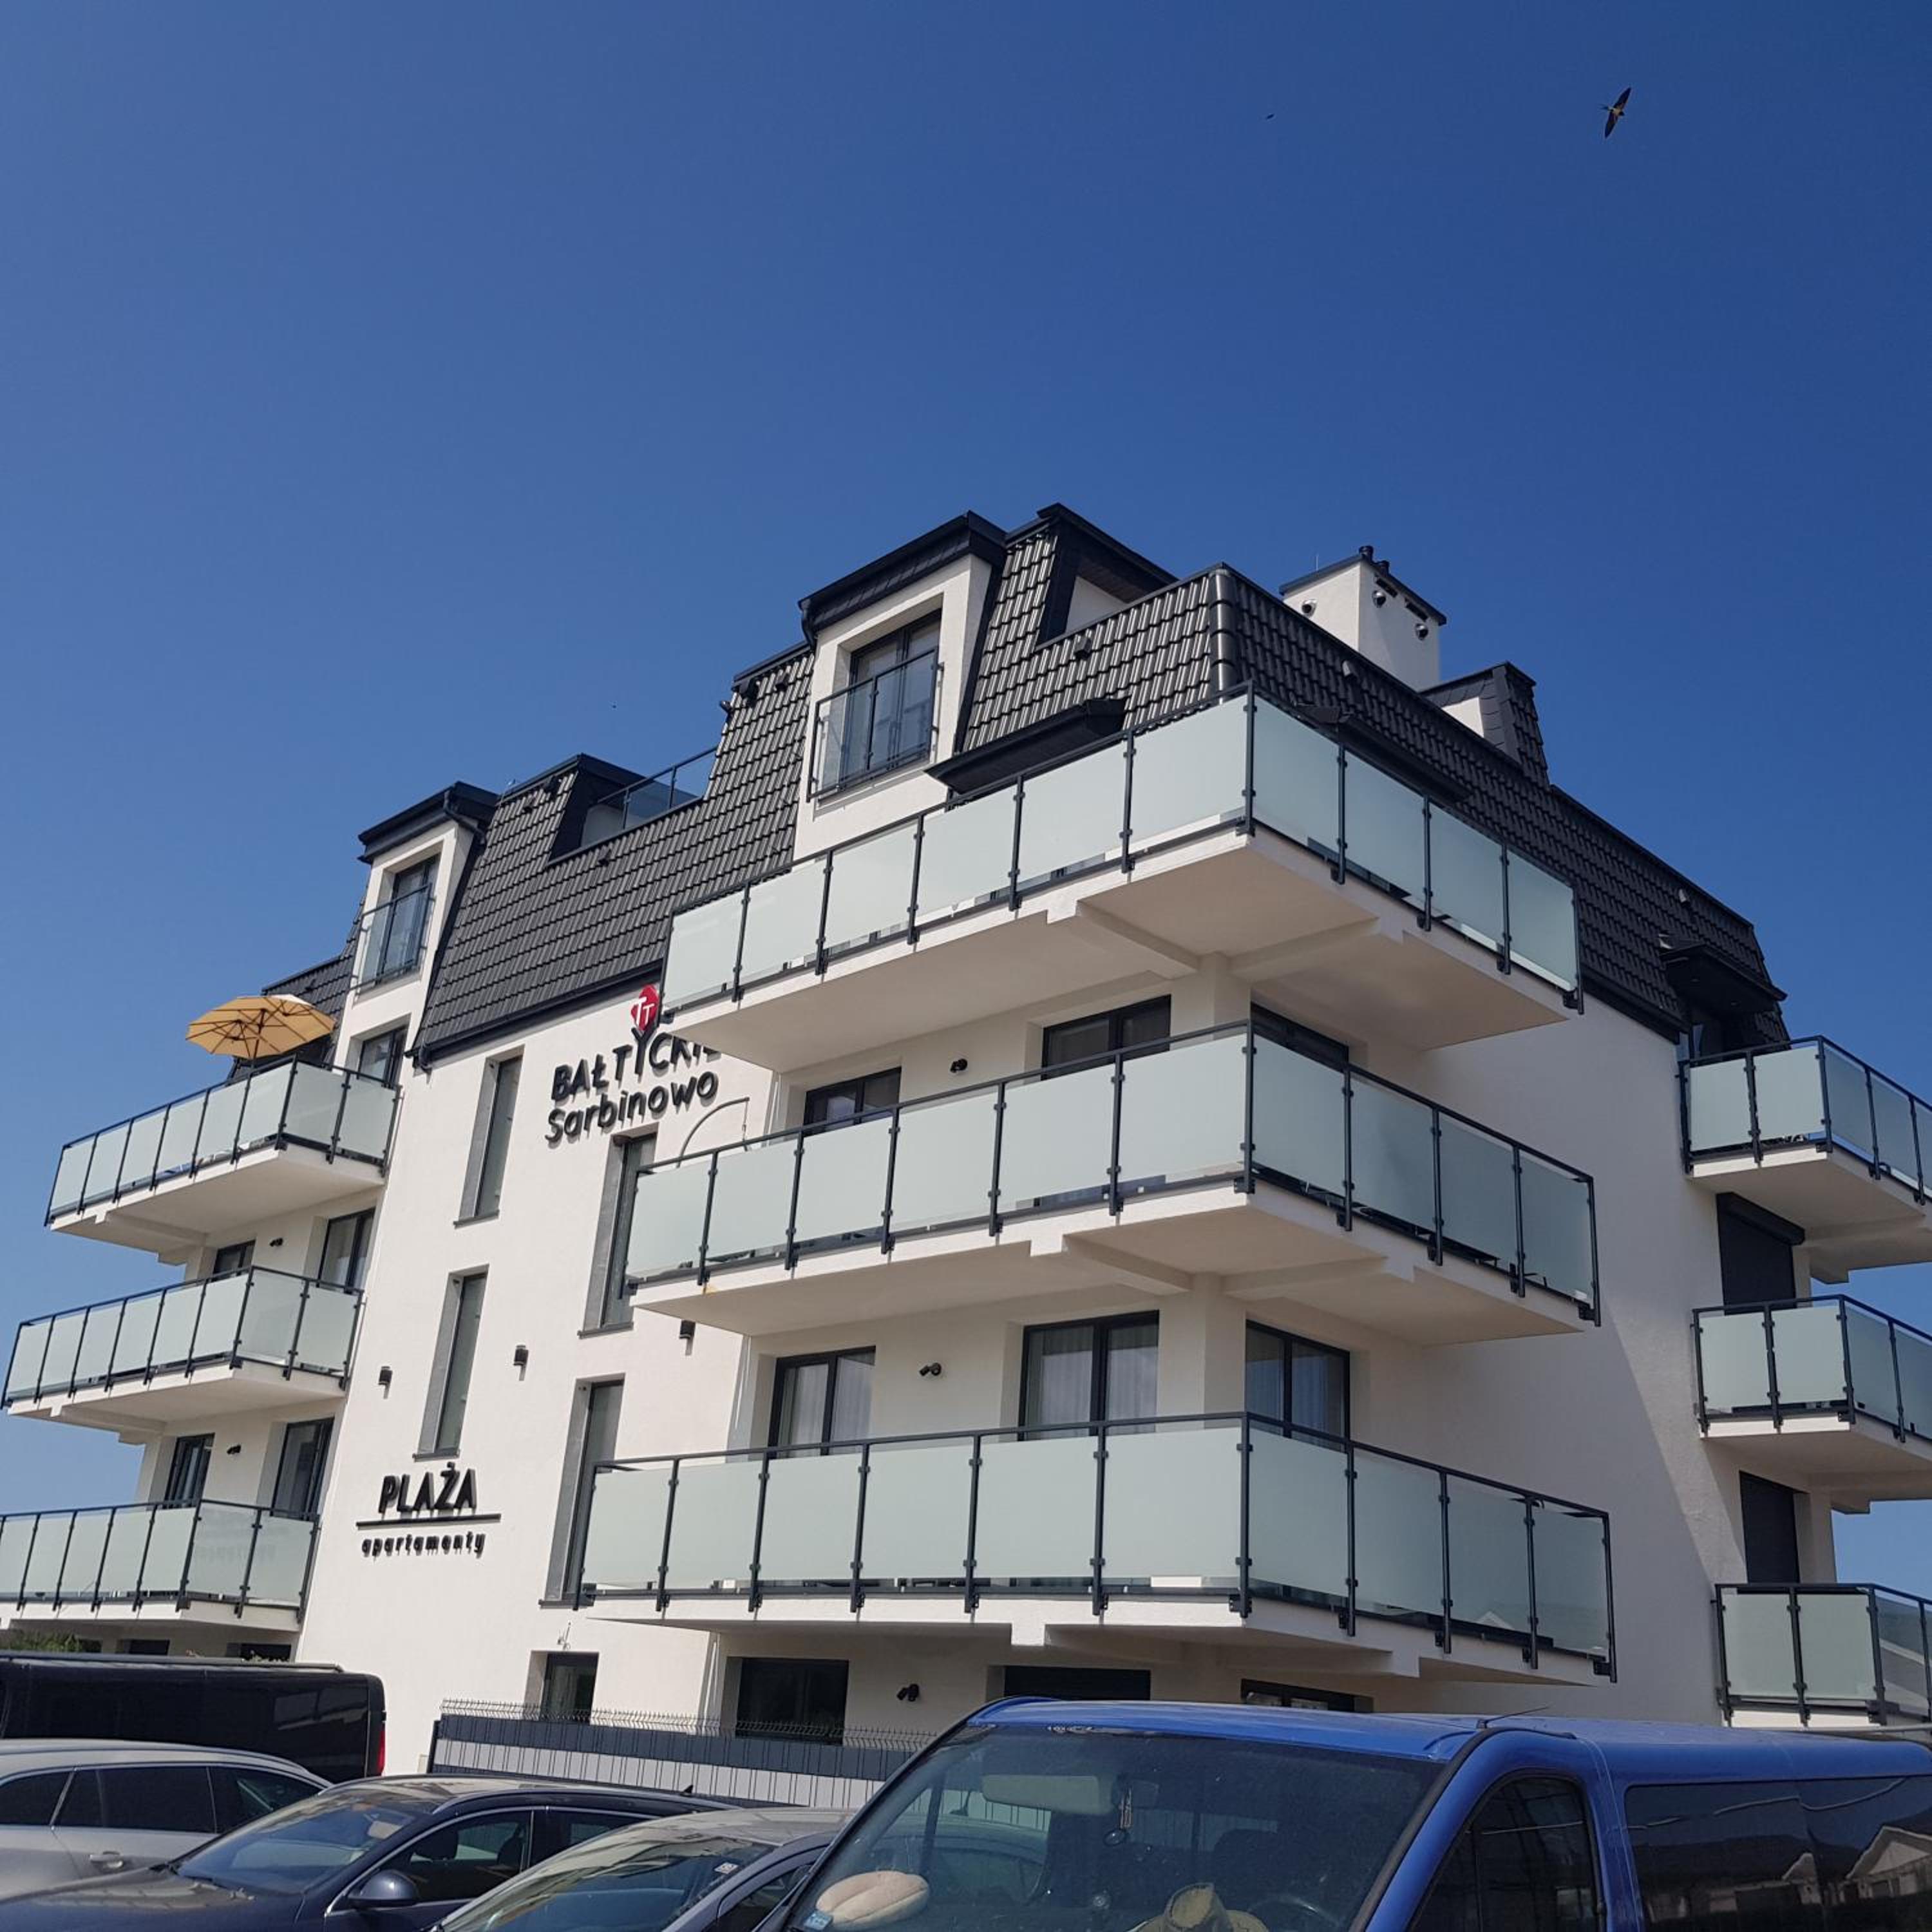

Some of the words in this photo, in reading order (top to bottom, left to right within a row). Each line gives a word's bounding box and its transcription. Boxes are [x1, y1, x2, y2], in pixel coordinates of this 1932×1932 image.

[551, 1025, 721, 1101] BAŁTYCK
[545, 1071, 718, 1144] Sarbinowo
[378, 1462, 477, 1513] PLAŻA
[361, 1531, 486, 1558] apartamenty
